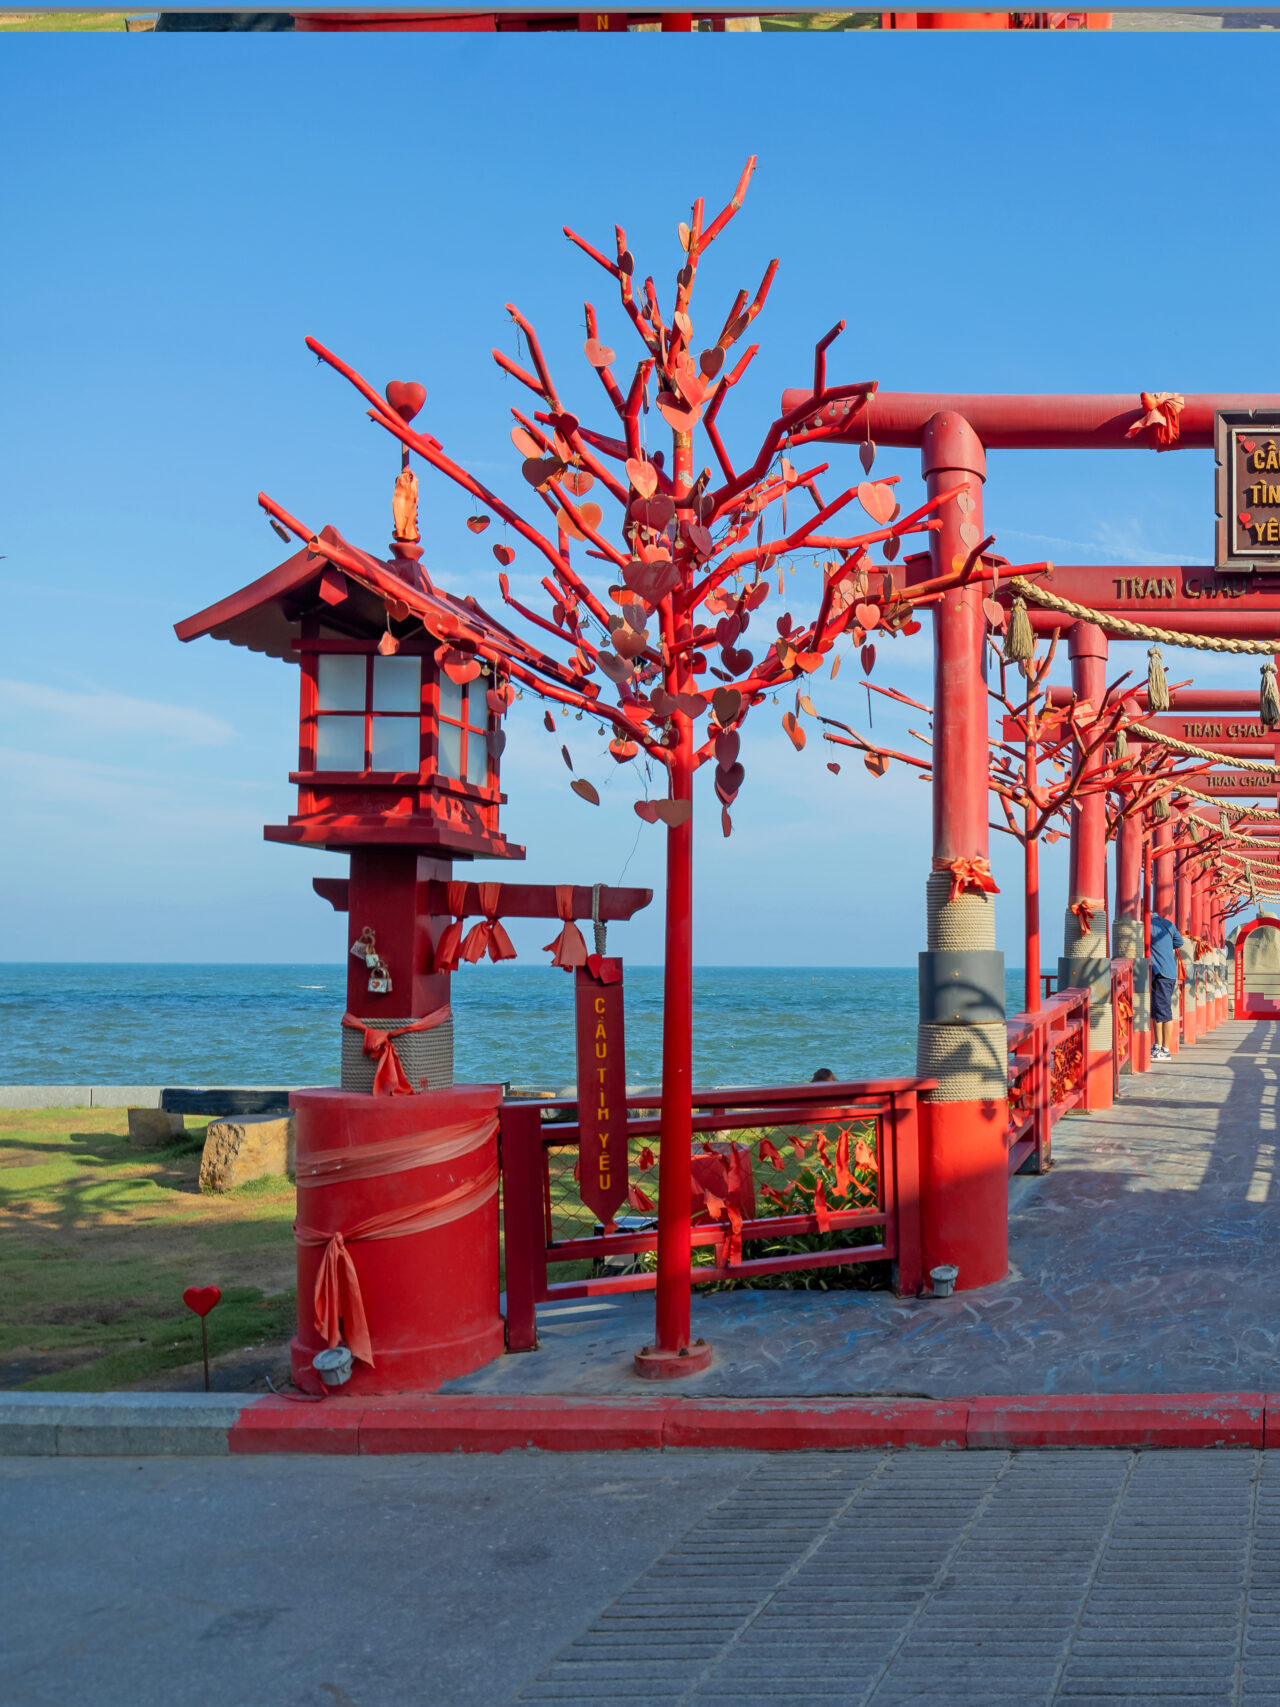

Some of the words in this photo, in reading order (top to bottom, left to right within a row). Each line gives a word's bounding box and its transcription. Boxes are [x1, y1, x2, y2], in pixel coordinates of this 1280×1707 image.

[1114, 576, 1176, 598] TRAN
[1186, 576, 1247, 598] CHAU
[1185, 722, 1222, 737] TRAN
[1228, 722, 1267, 737] CHAU
[1207, 776, 1238, 787] TRAN
[1239, 776, 1272, 787] CHAU
[599, 1133, 610, 1190] YÊU
